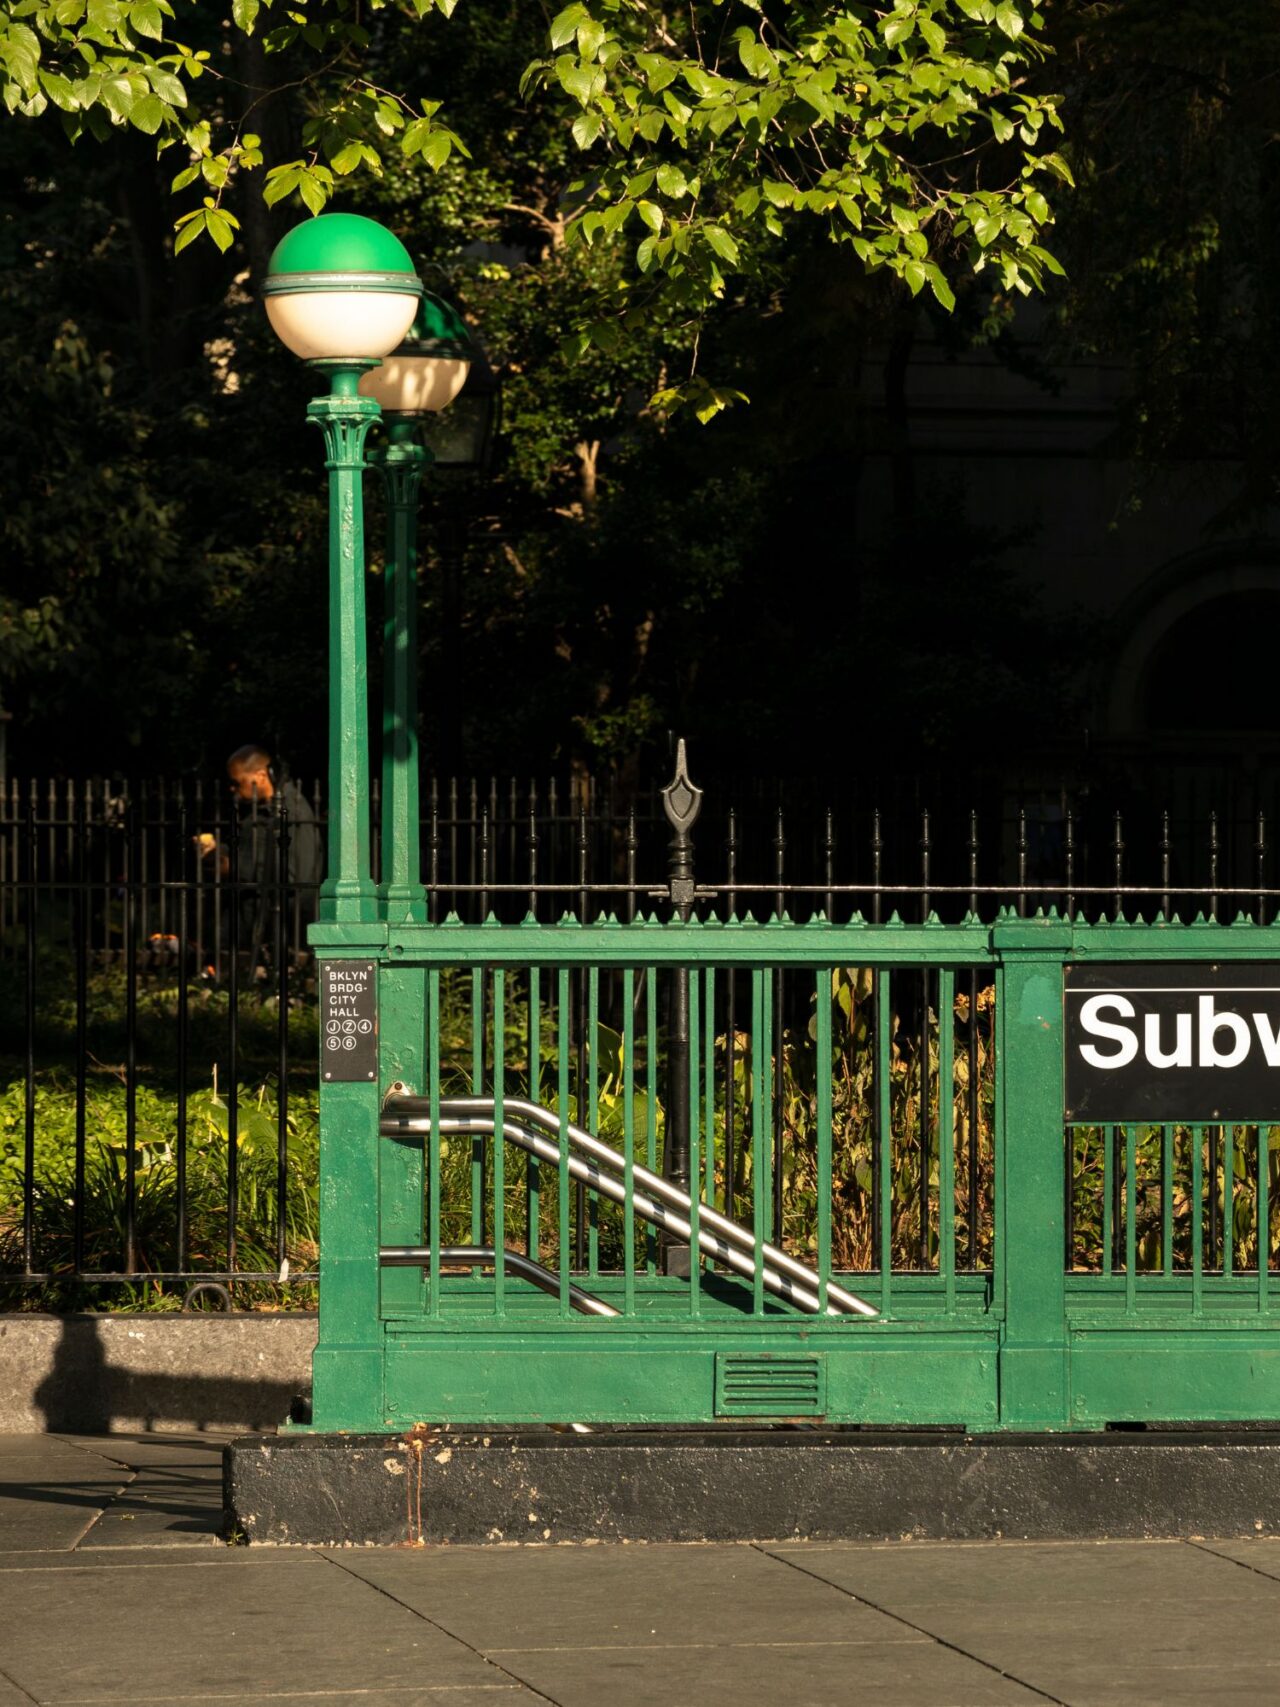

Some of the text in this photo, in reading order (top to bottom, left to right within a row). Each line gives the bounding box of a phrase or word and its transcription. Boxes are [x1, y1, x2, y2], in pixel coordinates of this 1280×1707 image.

[329, 971, 368, 981] BKLYN
[329, 983, 368, 993] BRDG-
[329, 995, 357, 1005] CITY
[329, 1007, 360, 1017] HALL
